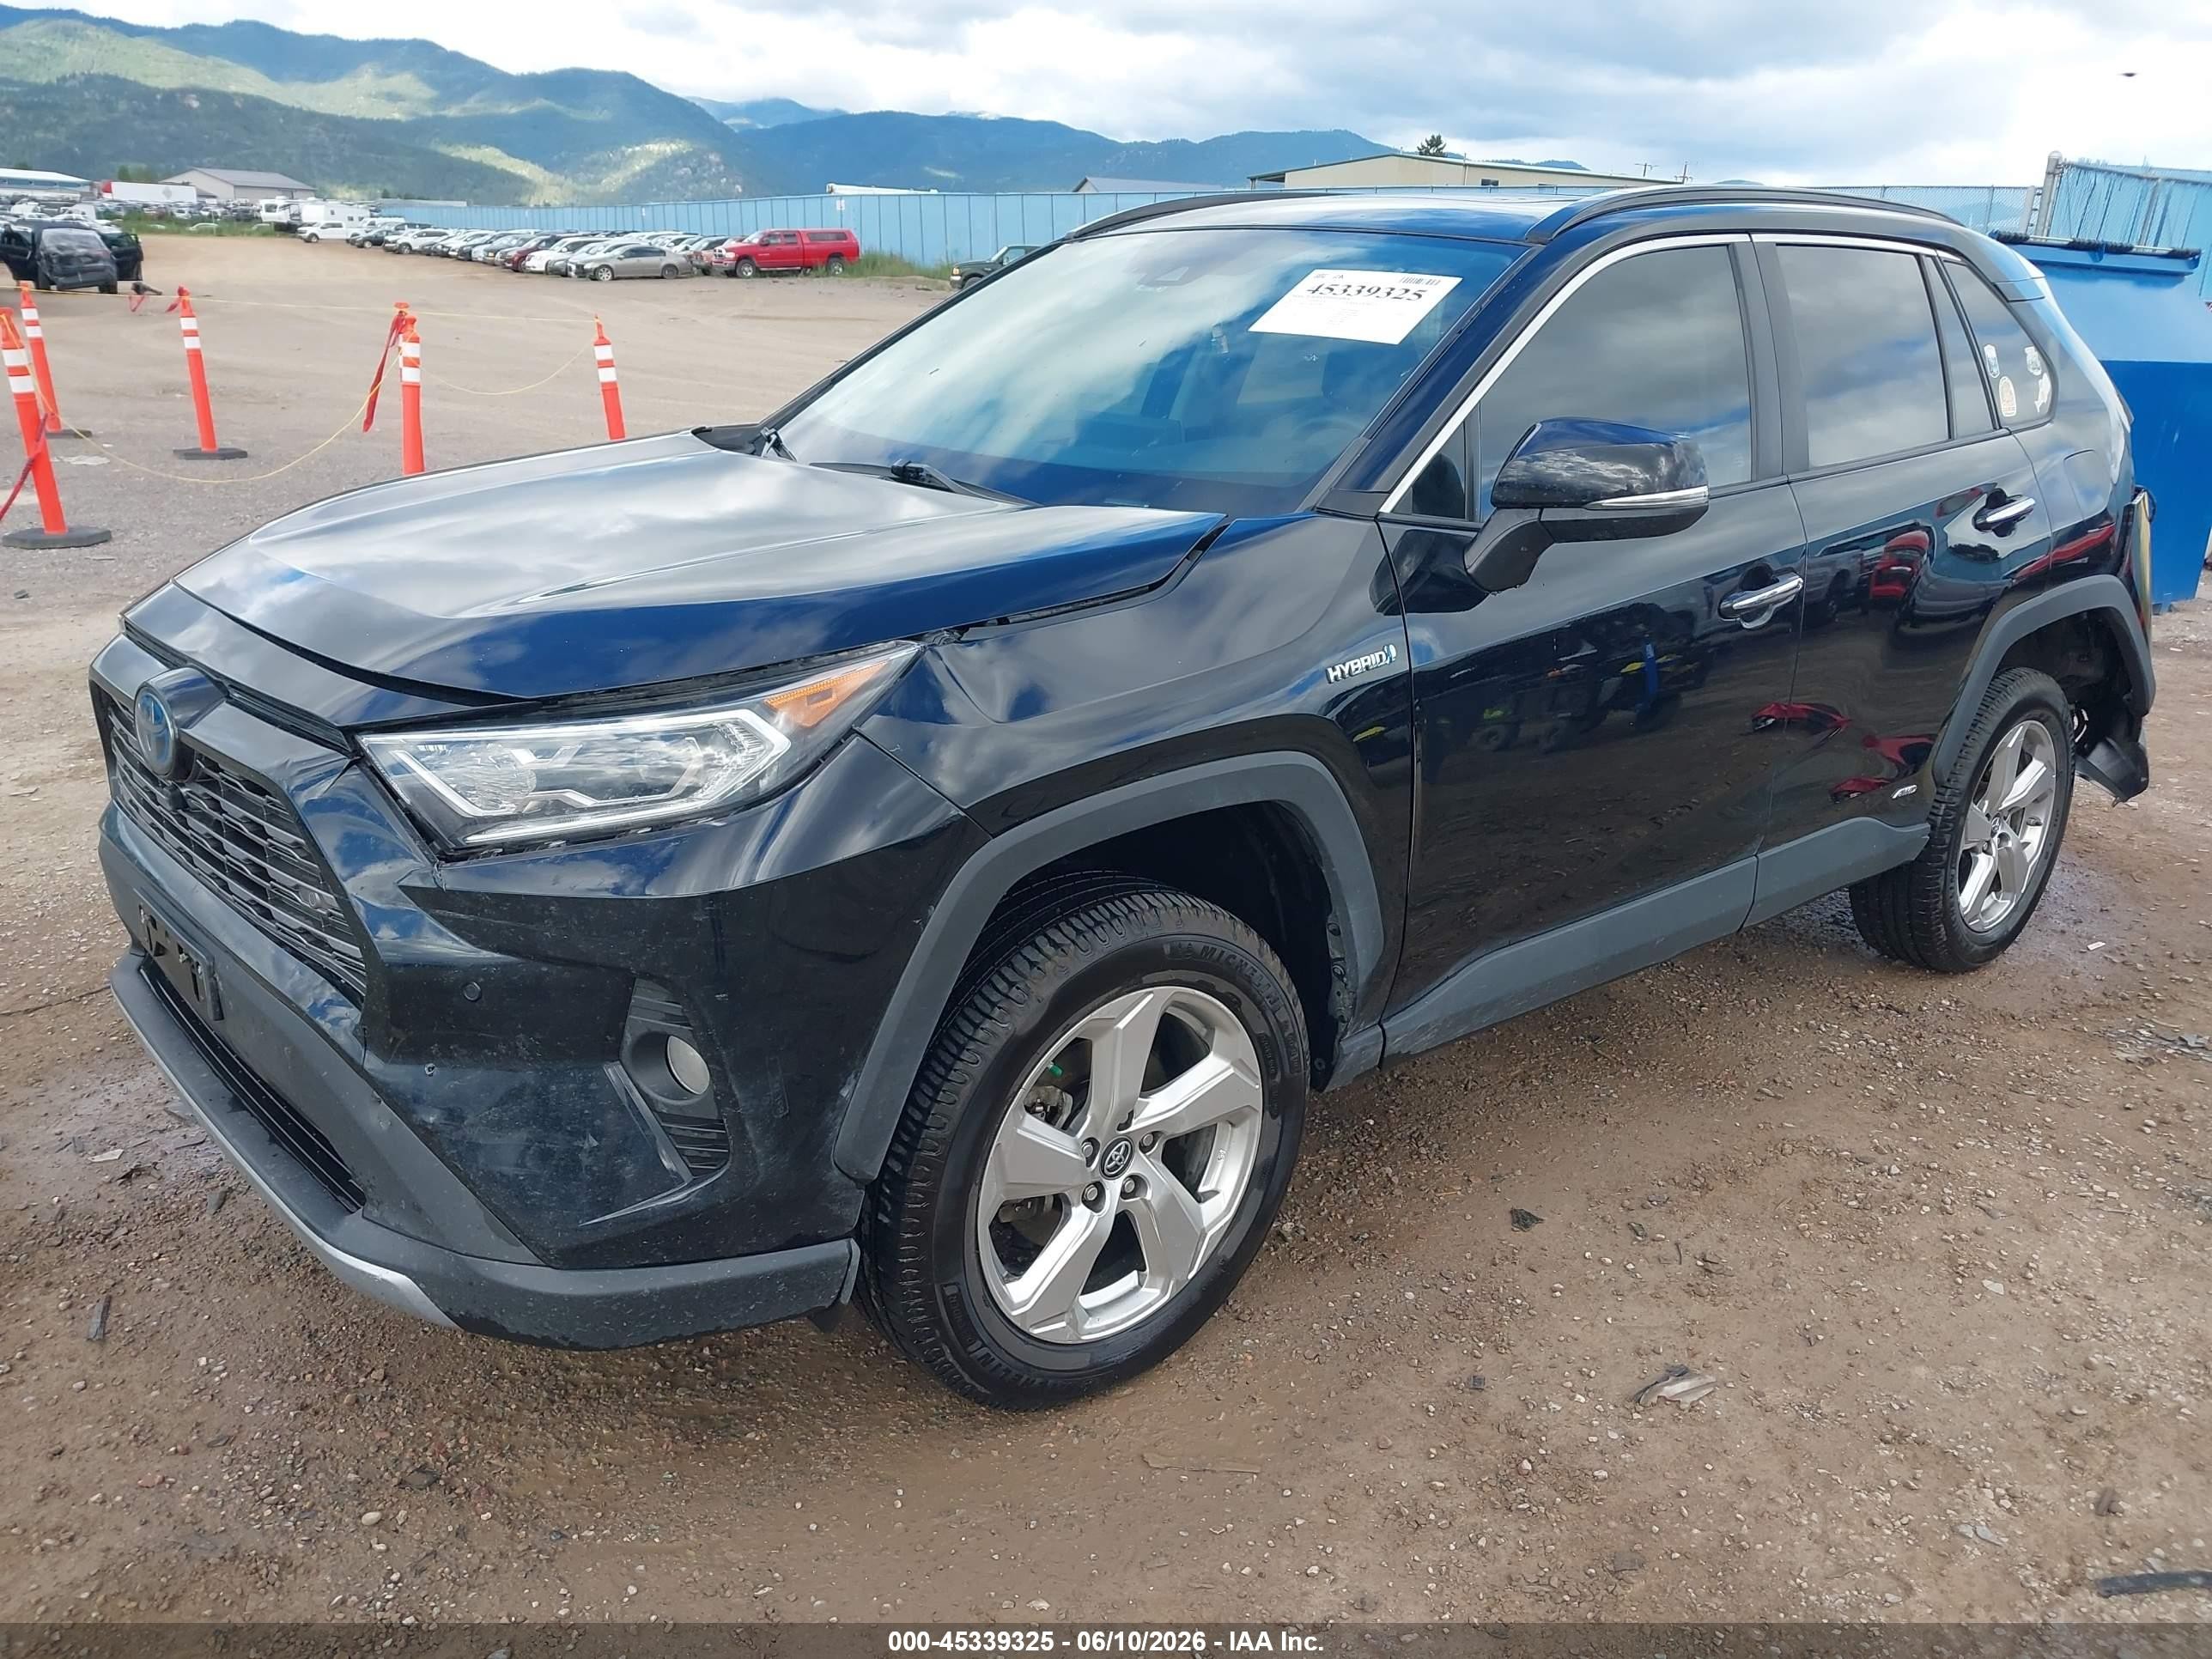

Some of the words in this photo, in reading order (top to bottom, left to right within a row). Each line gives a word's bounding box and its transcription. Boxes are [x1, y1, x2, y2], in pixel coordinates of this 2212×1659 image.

[1306, 283, 1428, 301] 45339325
[1327, 651, 1387, 684] HYBRID
[1200, 945, 1282, 1013] MICHELIN
